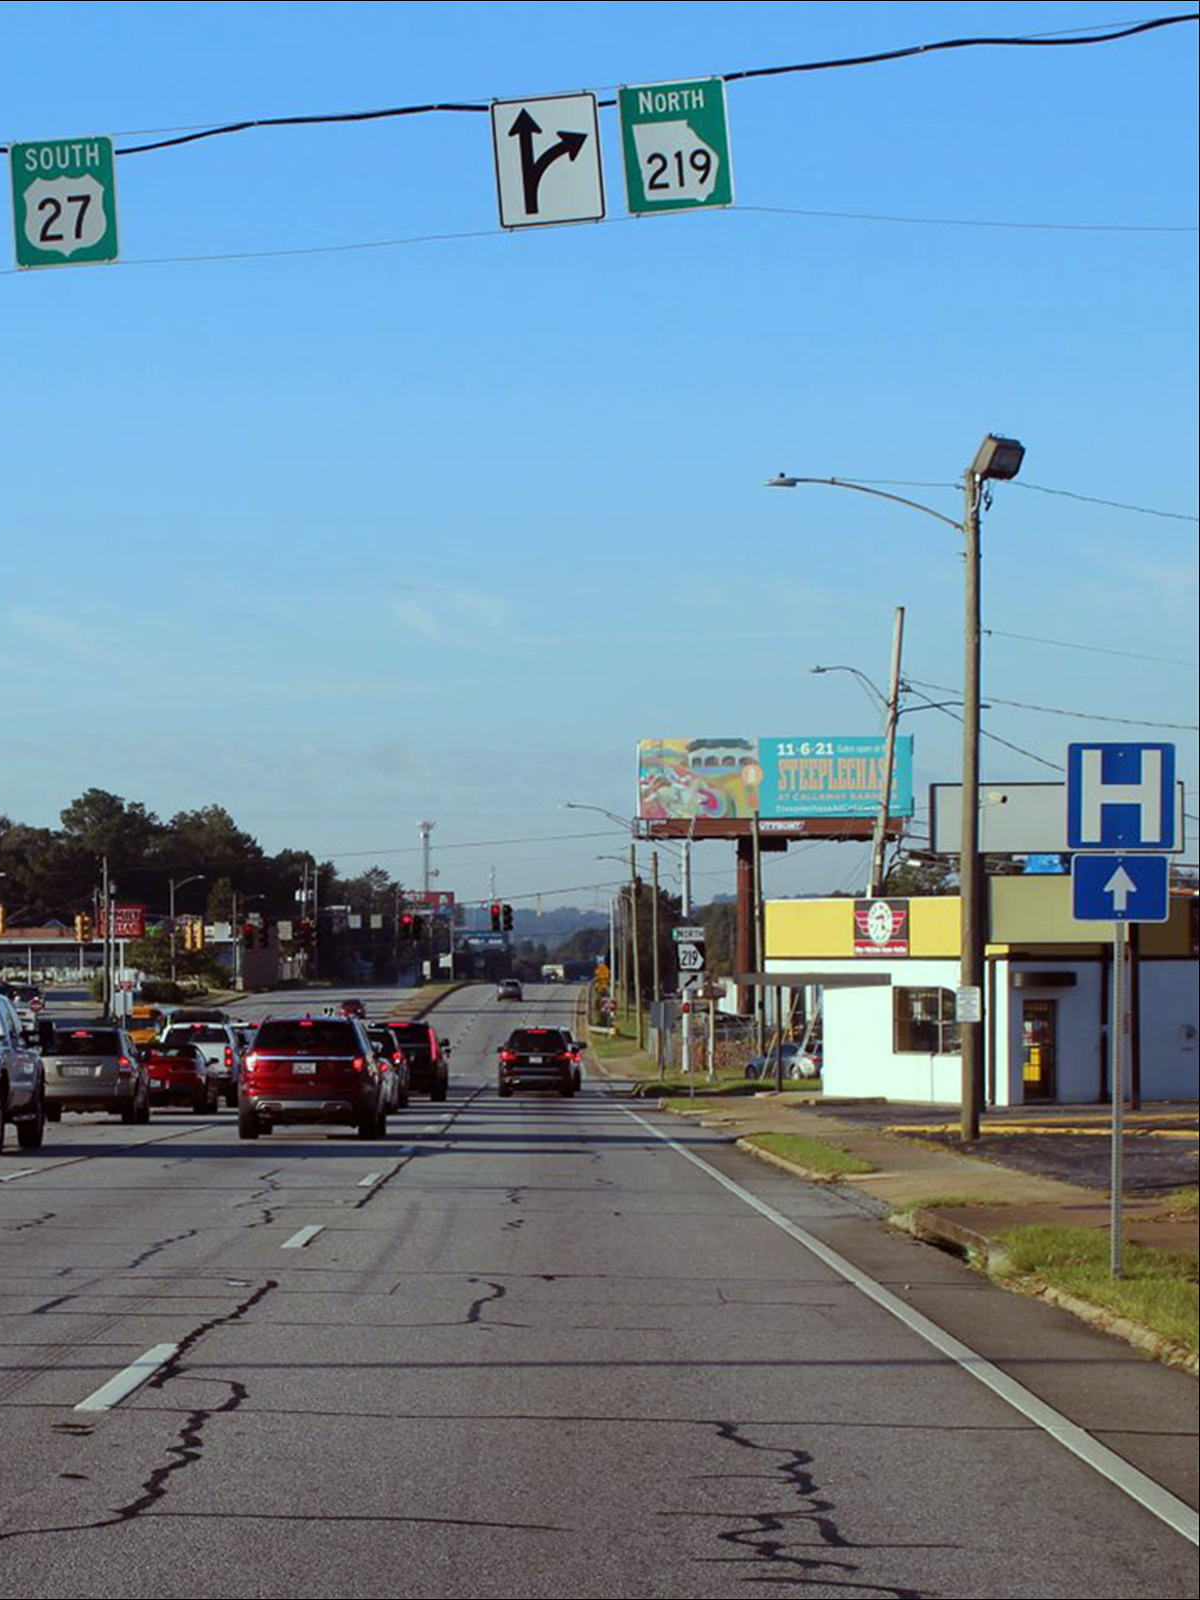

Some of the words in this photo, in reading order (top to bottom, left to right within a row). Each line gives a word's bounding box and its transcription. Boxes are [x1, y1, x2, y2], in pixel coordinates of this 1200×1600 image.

[638, 89, 705, 115] NORTH
[25, 143, 99, 171] SOUTH
[647, 148, 711, 190] 219
[38, 194, 91, 242] 27
[779, 757, 898, 790] STEEPLECHAS
[1081, 749, 1162, 843] H
[681, 950, 699, 967] 219
